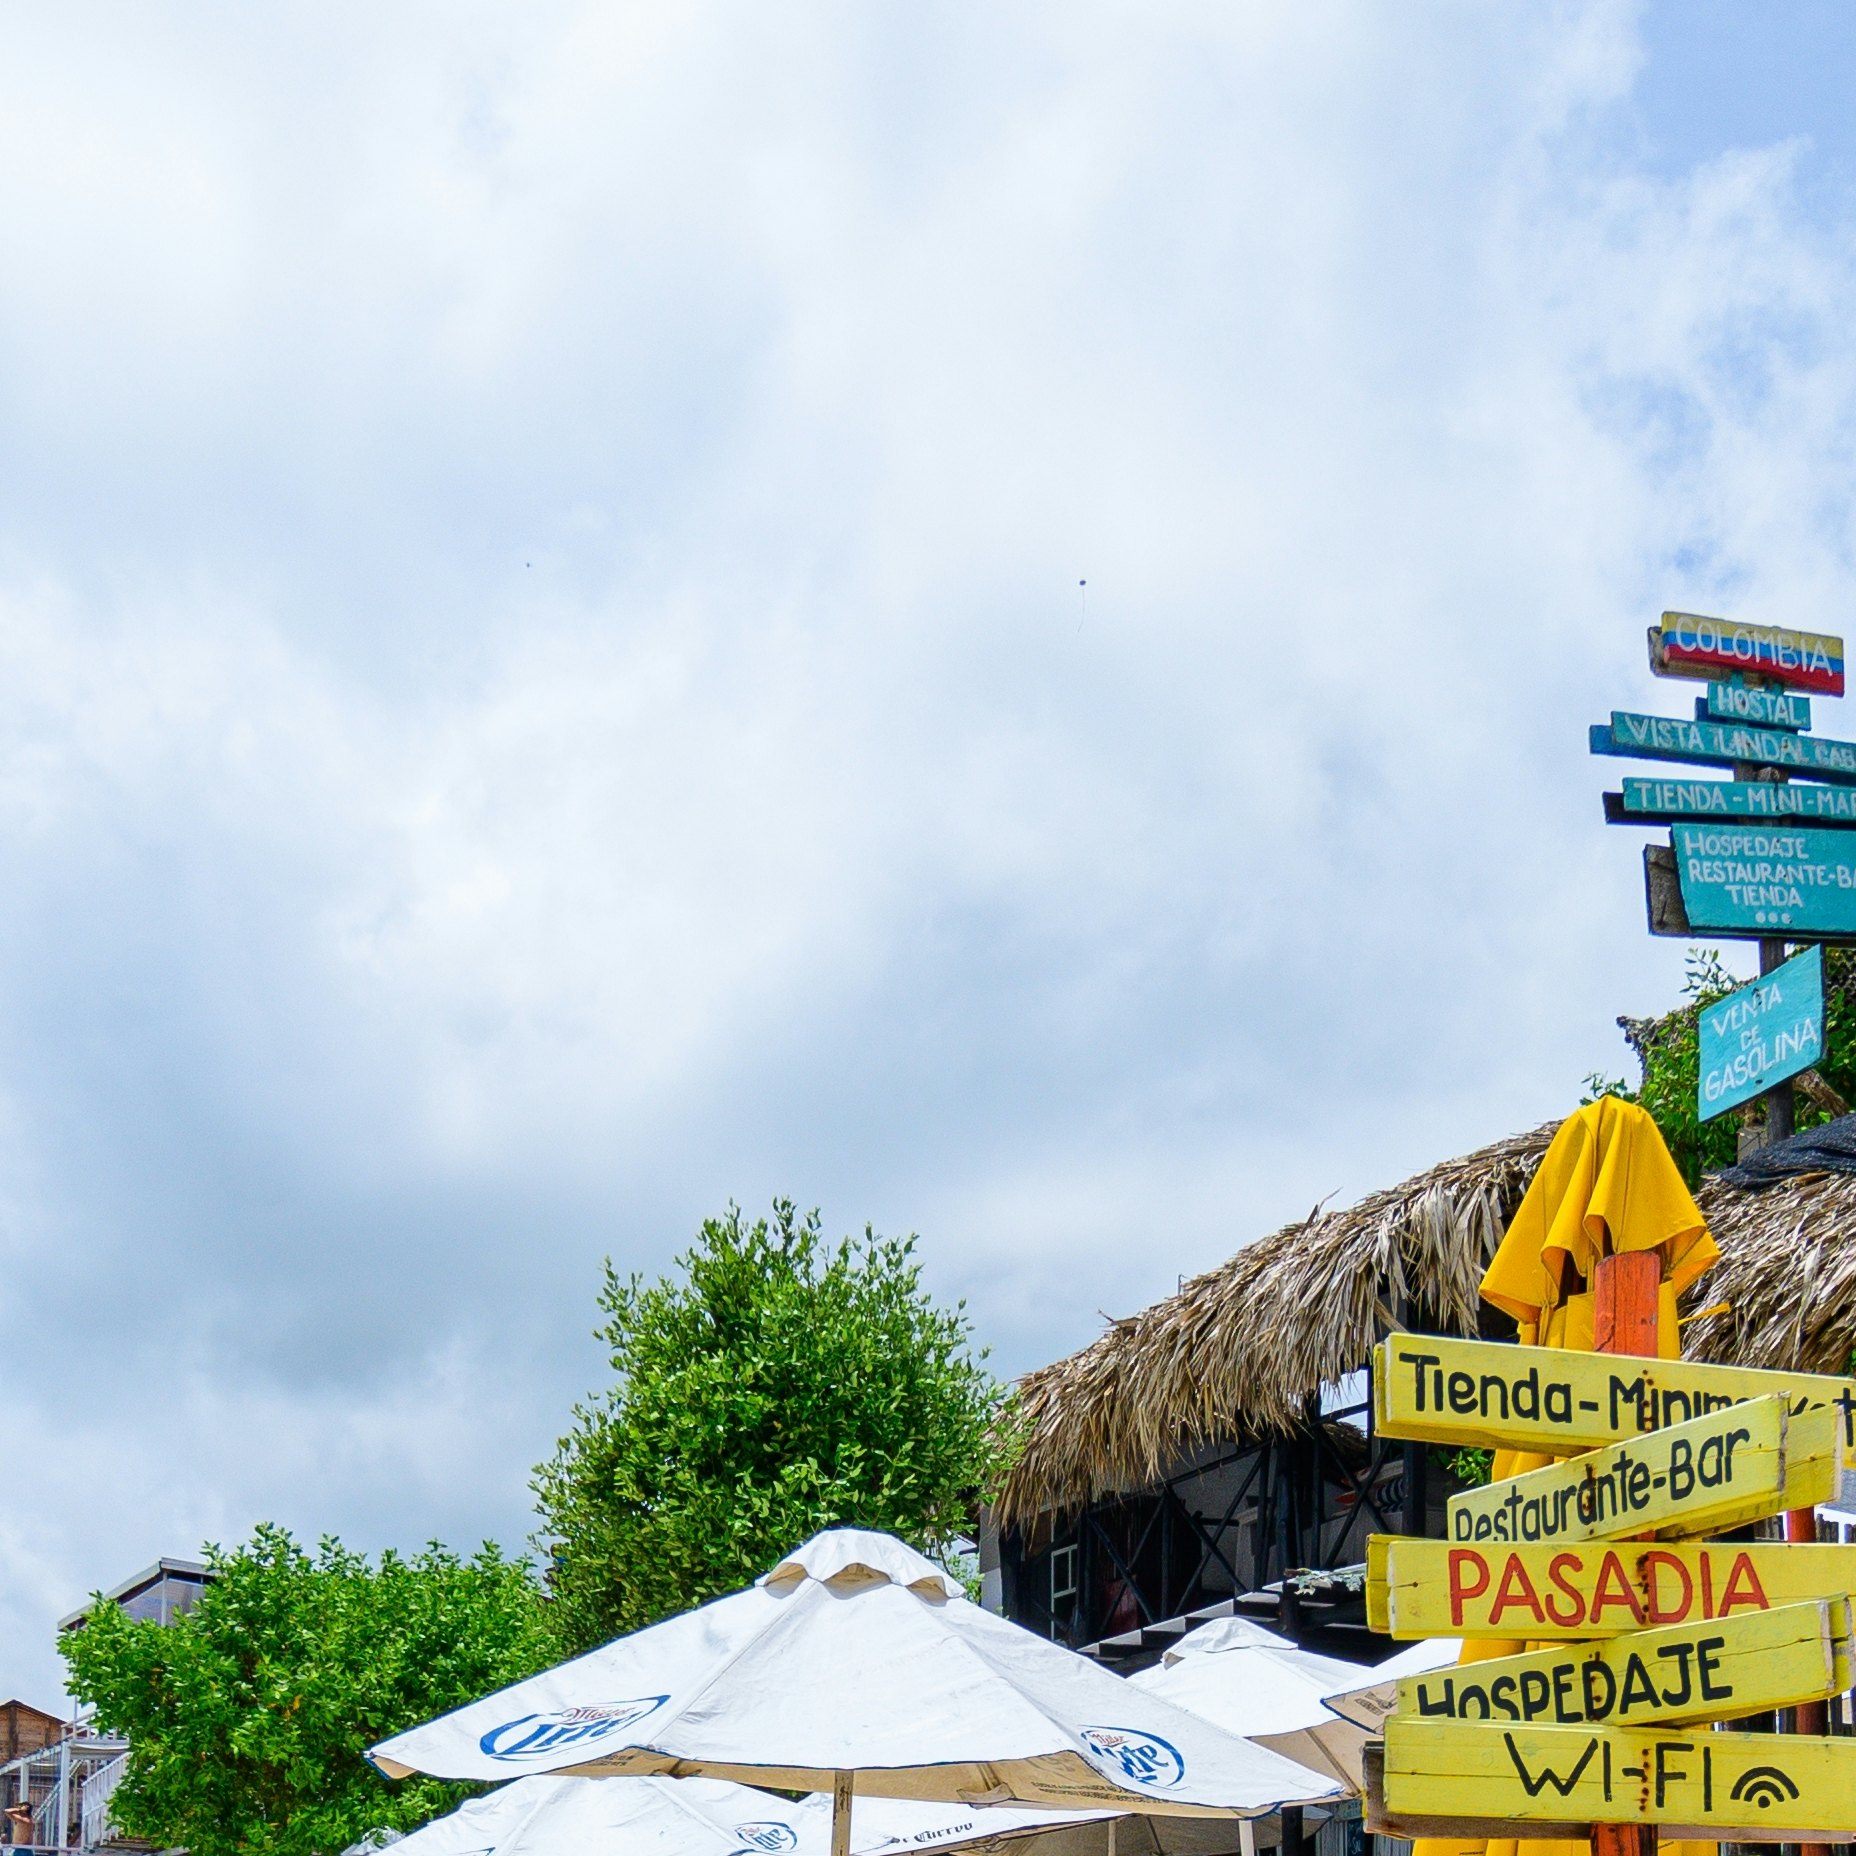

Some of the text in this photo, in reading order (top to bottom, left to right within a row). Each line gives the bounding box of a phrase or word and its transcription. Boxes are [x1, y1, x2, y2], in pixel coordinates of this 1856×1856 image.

[1675, 616, 1834, 676] COLOMBIA
[1625, 714, 1705, 750] VISTA
[1633, 782, 1729, 811] TIENDA
[1684, 832, 1810, 860] HOSPEDAJE
[1725, 884, 1805, 908] TIENDA
[1711, 983, 1783, 1039] VENTA
[1704, 1018, 1819, 1102] GASOLINA
[1455, 1427, 1751, 1541] Restaurante-Bar
[1447, 1548, 1771, 1627] PASADIA
[1417, 1636, 1734, 1722] HOSPEDAJE
[1503, 1732, 1714, 1813] WI-FI
